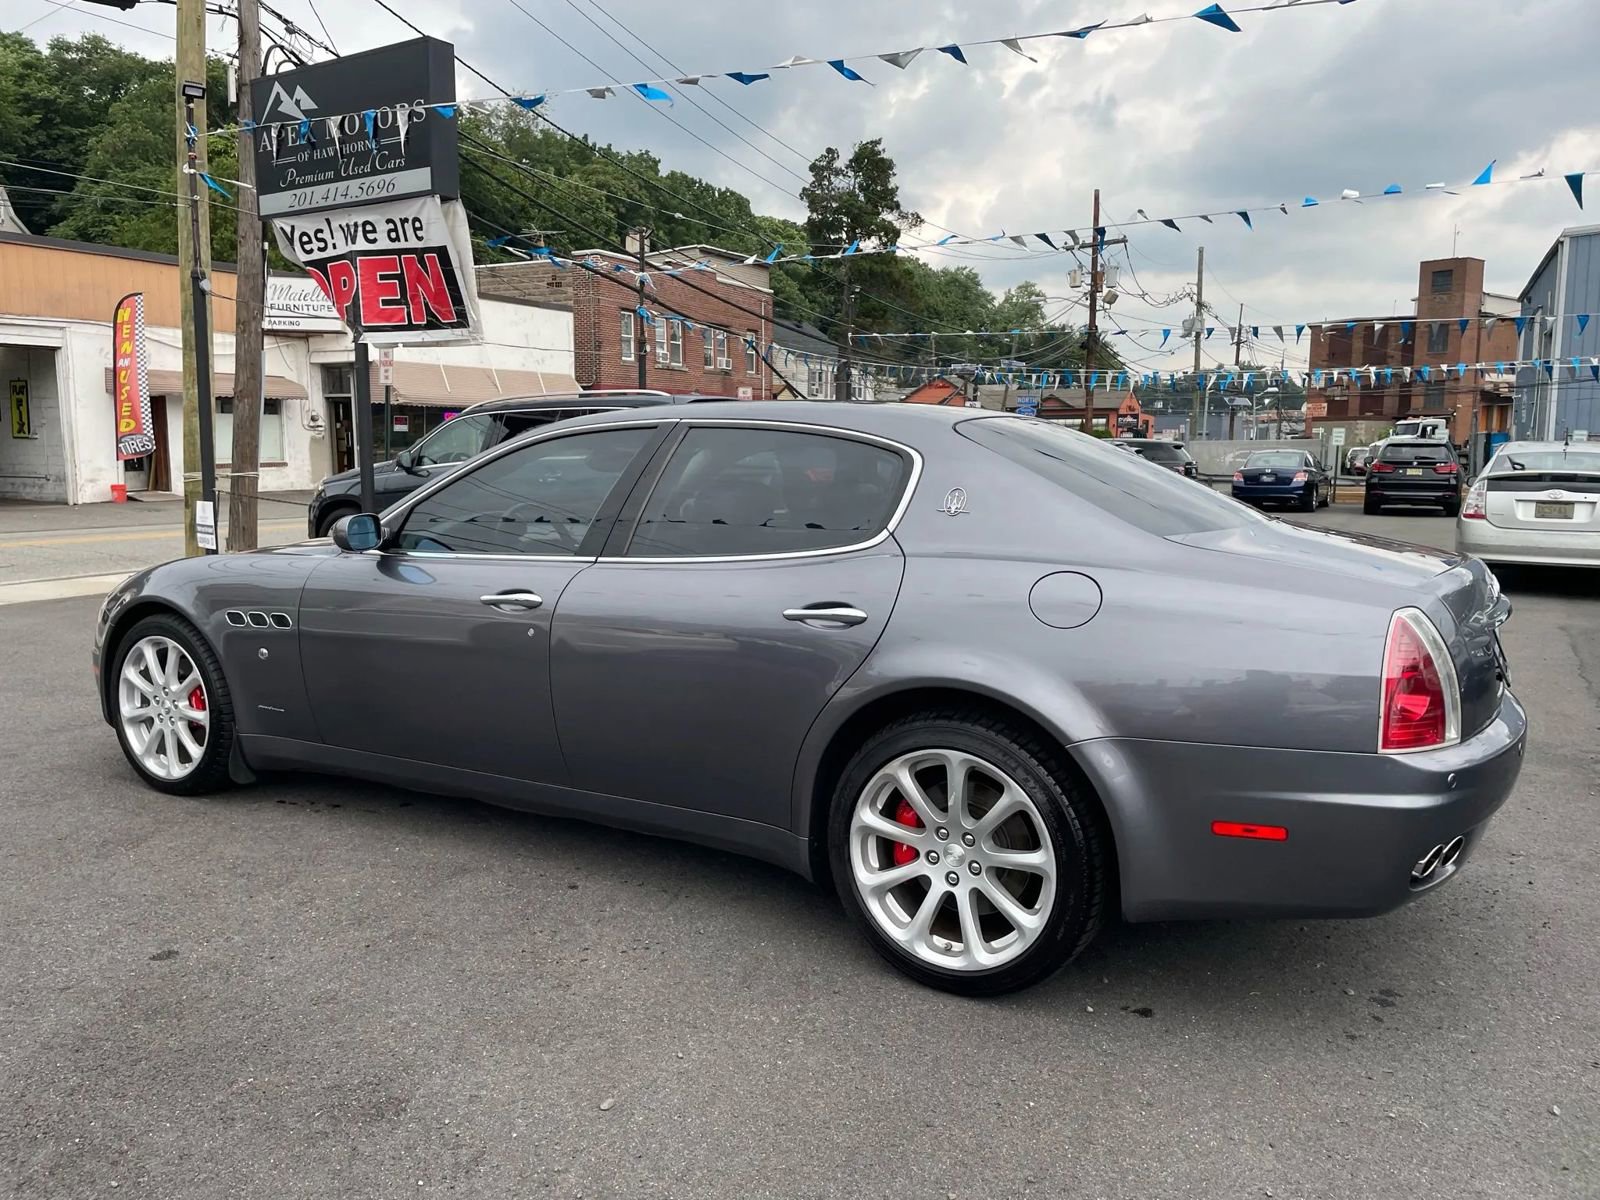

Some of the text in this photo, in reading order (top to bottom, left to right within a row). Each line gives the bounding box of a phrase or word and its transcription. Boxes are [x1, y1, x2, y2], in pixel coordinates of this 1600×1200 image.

[325, 99, 426, 140] MOORS
[279, 150, 406, 188] Premium Used Cars
[297, 151, 310, 163] OF
[288, 176, 396, 209] 201.414.5696
[280, 216, 425, 255] Yes! we are
[306, 253, 457, 327] PEN
[267, 319, 301, 327] PARKING
[269, 303, 334, 313] FURNITURE
[119, 369, 137, 432] USED
[118, 436, 153, 456] TIRES
